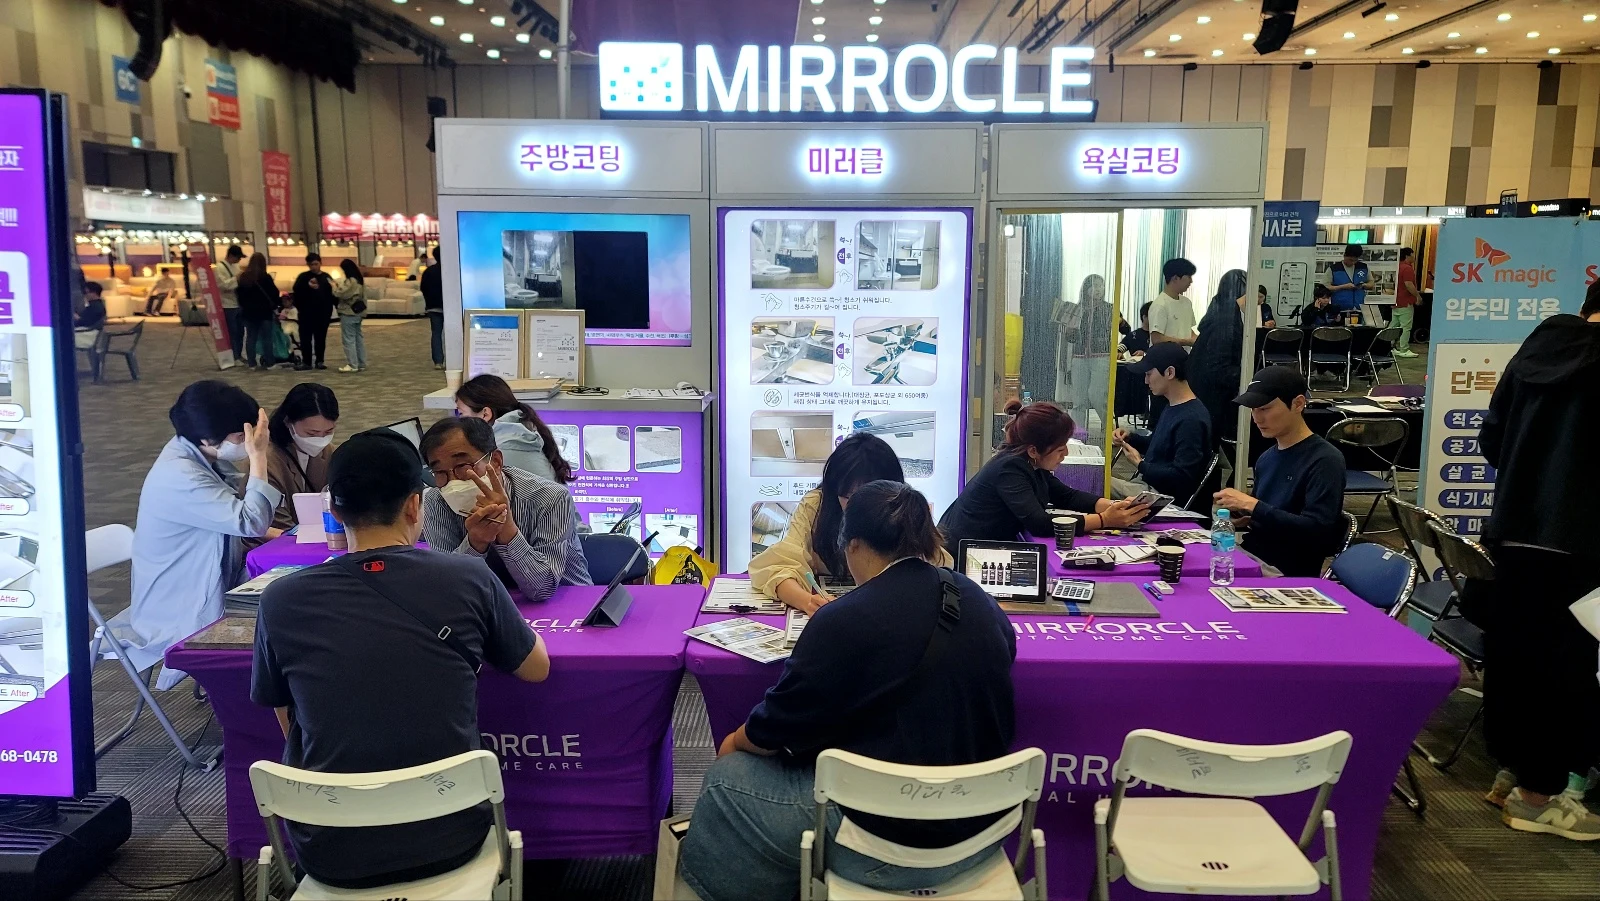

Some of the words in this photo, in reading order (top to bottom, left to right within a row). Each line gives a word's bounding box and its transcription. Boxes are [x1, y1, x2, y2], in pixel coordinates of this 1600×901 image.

[695, 44, 1096, 113] MIRROCLE
[519, 144, 620, 172] 주방코팅
[808, 147, 883, 174] 미러클
[1082, 147, 1179, 175] 욕실코팅
[1451, 262, 1485, 283] SK
[1494, 264, 1557, 289] magic
[1445, 298, 1511, 321] 입주민
[1516, 298, 1561, 321] 전용
[1093, 634, 1165, 642] HOME
[1182, 634, 1249, 642] CARE
[10, 689, 30, 698] After
[535, 761, 583, 771] CARE
